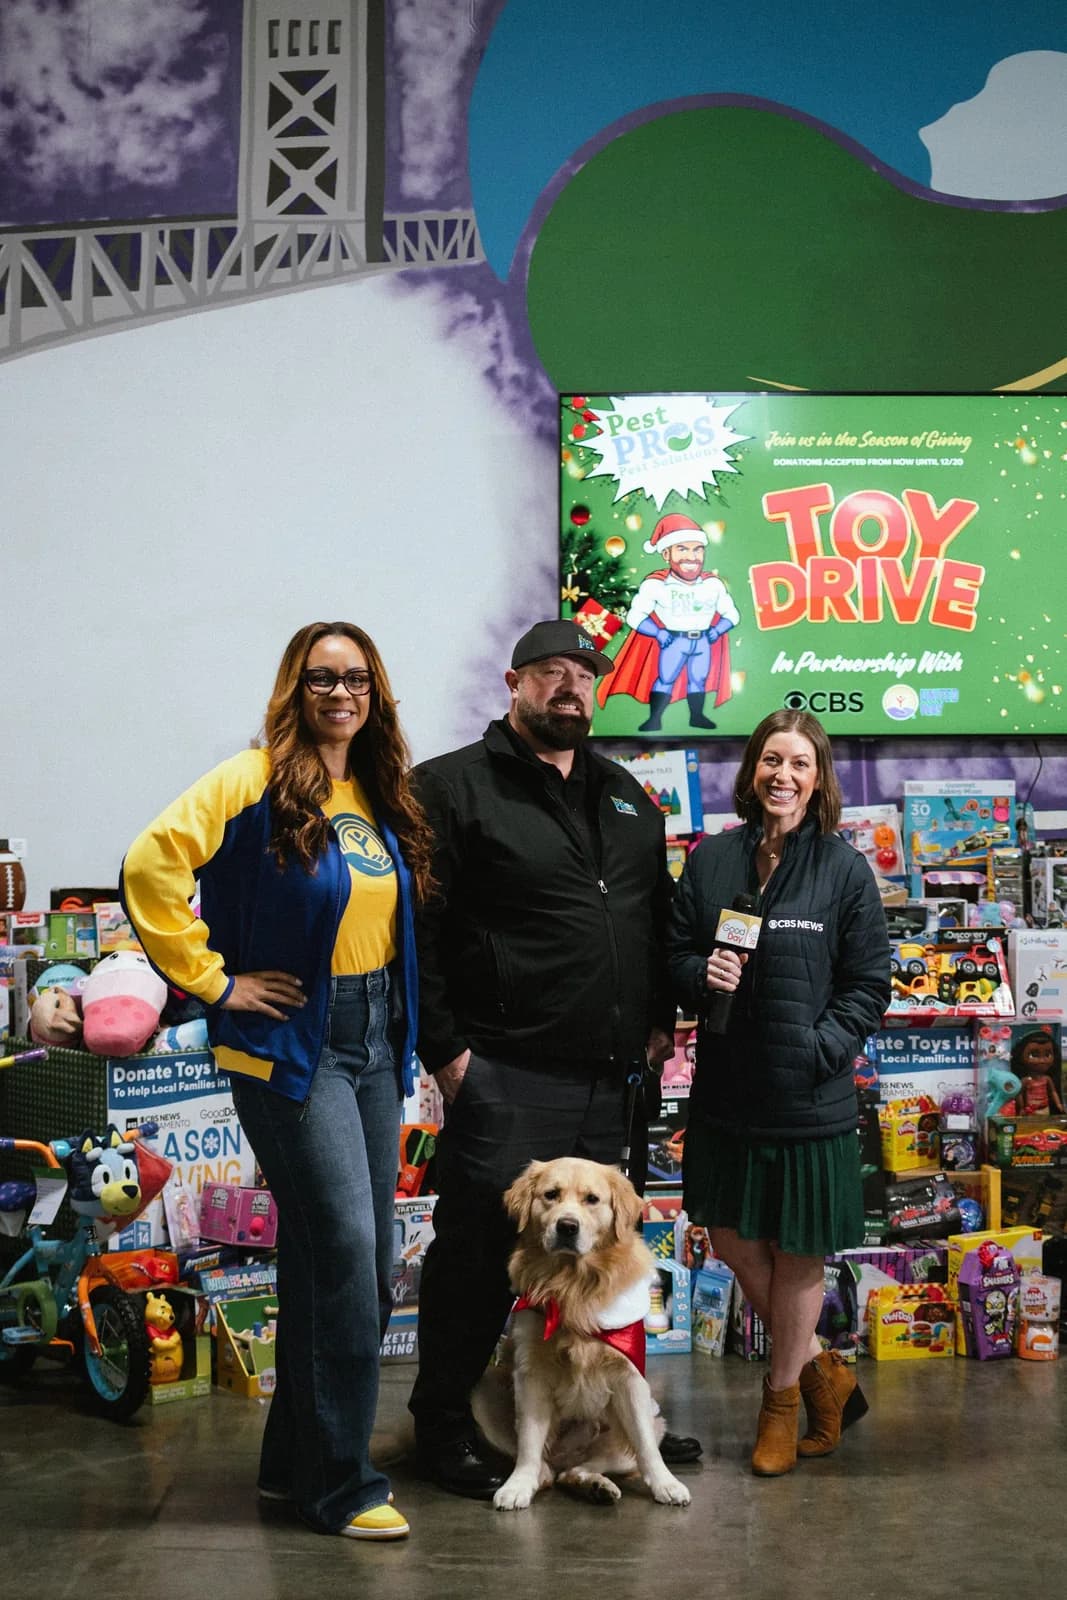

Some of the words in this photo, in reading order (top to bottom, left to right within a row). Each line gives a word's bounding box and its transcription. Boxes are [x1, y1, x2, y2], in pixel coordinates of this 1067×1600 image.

[606, 405, 669, 437] Pest
[765, 431, 797, 451] Join
[798, 435, 817, 448] us
[816, 431, 833, 447] in
[834, 431, 858, 447] the
[857, 430, 909, 449] Season
[910, 431, 929, 449] of
[925, 430, 973, 454] Giving
[773, 457, 823, 467] DONATIONS
[824, 457, 867, 467] ACCEPTED
[867, 457, 892, 467] FROM
[893, 457, 915, 467] NOW
[915, 457, 940, 467] UNTIL
[941, 457, 964, 467] 12/20
[762, 482, 980, 566] TOY
[749, 555, 986, 632] DRIVE
[770, 651, 795, 675] In
[794, 651, 917, 679] Partnership
[917, 650, 964, 675] With
[808, 692, 864, 713] CBS
[911, 803, 931, 816] 30
[722, 923, 746, 936] Good
[777, 919, 797, 928] CBS
[797, 920, 824, 932] NEWS
[727, 932, 743, 944] Day
[943, 930, 988, 940] Discovery
[876, 1036, 905, 1050] ate
[908, 1035, 951, 1054] Toys
[881, 1054, 910, 1064] Local
[912, 1053, 956, 1064] Families
[958, 1054, 969, 1064] in
[112, 1064, 173, 1084] Donate
[175, 1061, 211, 1080] Toys
[113, 1087, 126, 1098] To
[127, 1085, 151, 1098] Help
[152, 1082, 177, 1094] Local
[178, 1079, 216, 1092] Families
[217, 1078, 226, 1088] in
[890, 1081, 914, 1089] NEWS
[881, 1089, 926, 1097] RAMENTO
[159, 1112, 181, 1122] NEWS
[200, 1107, 238, 1119] GoodDa
[159, 1118, 191, 1129] AMENTO
[163, 1123, 241, 1163] ASON
[138, 1231, 150, 1245] 14
